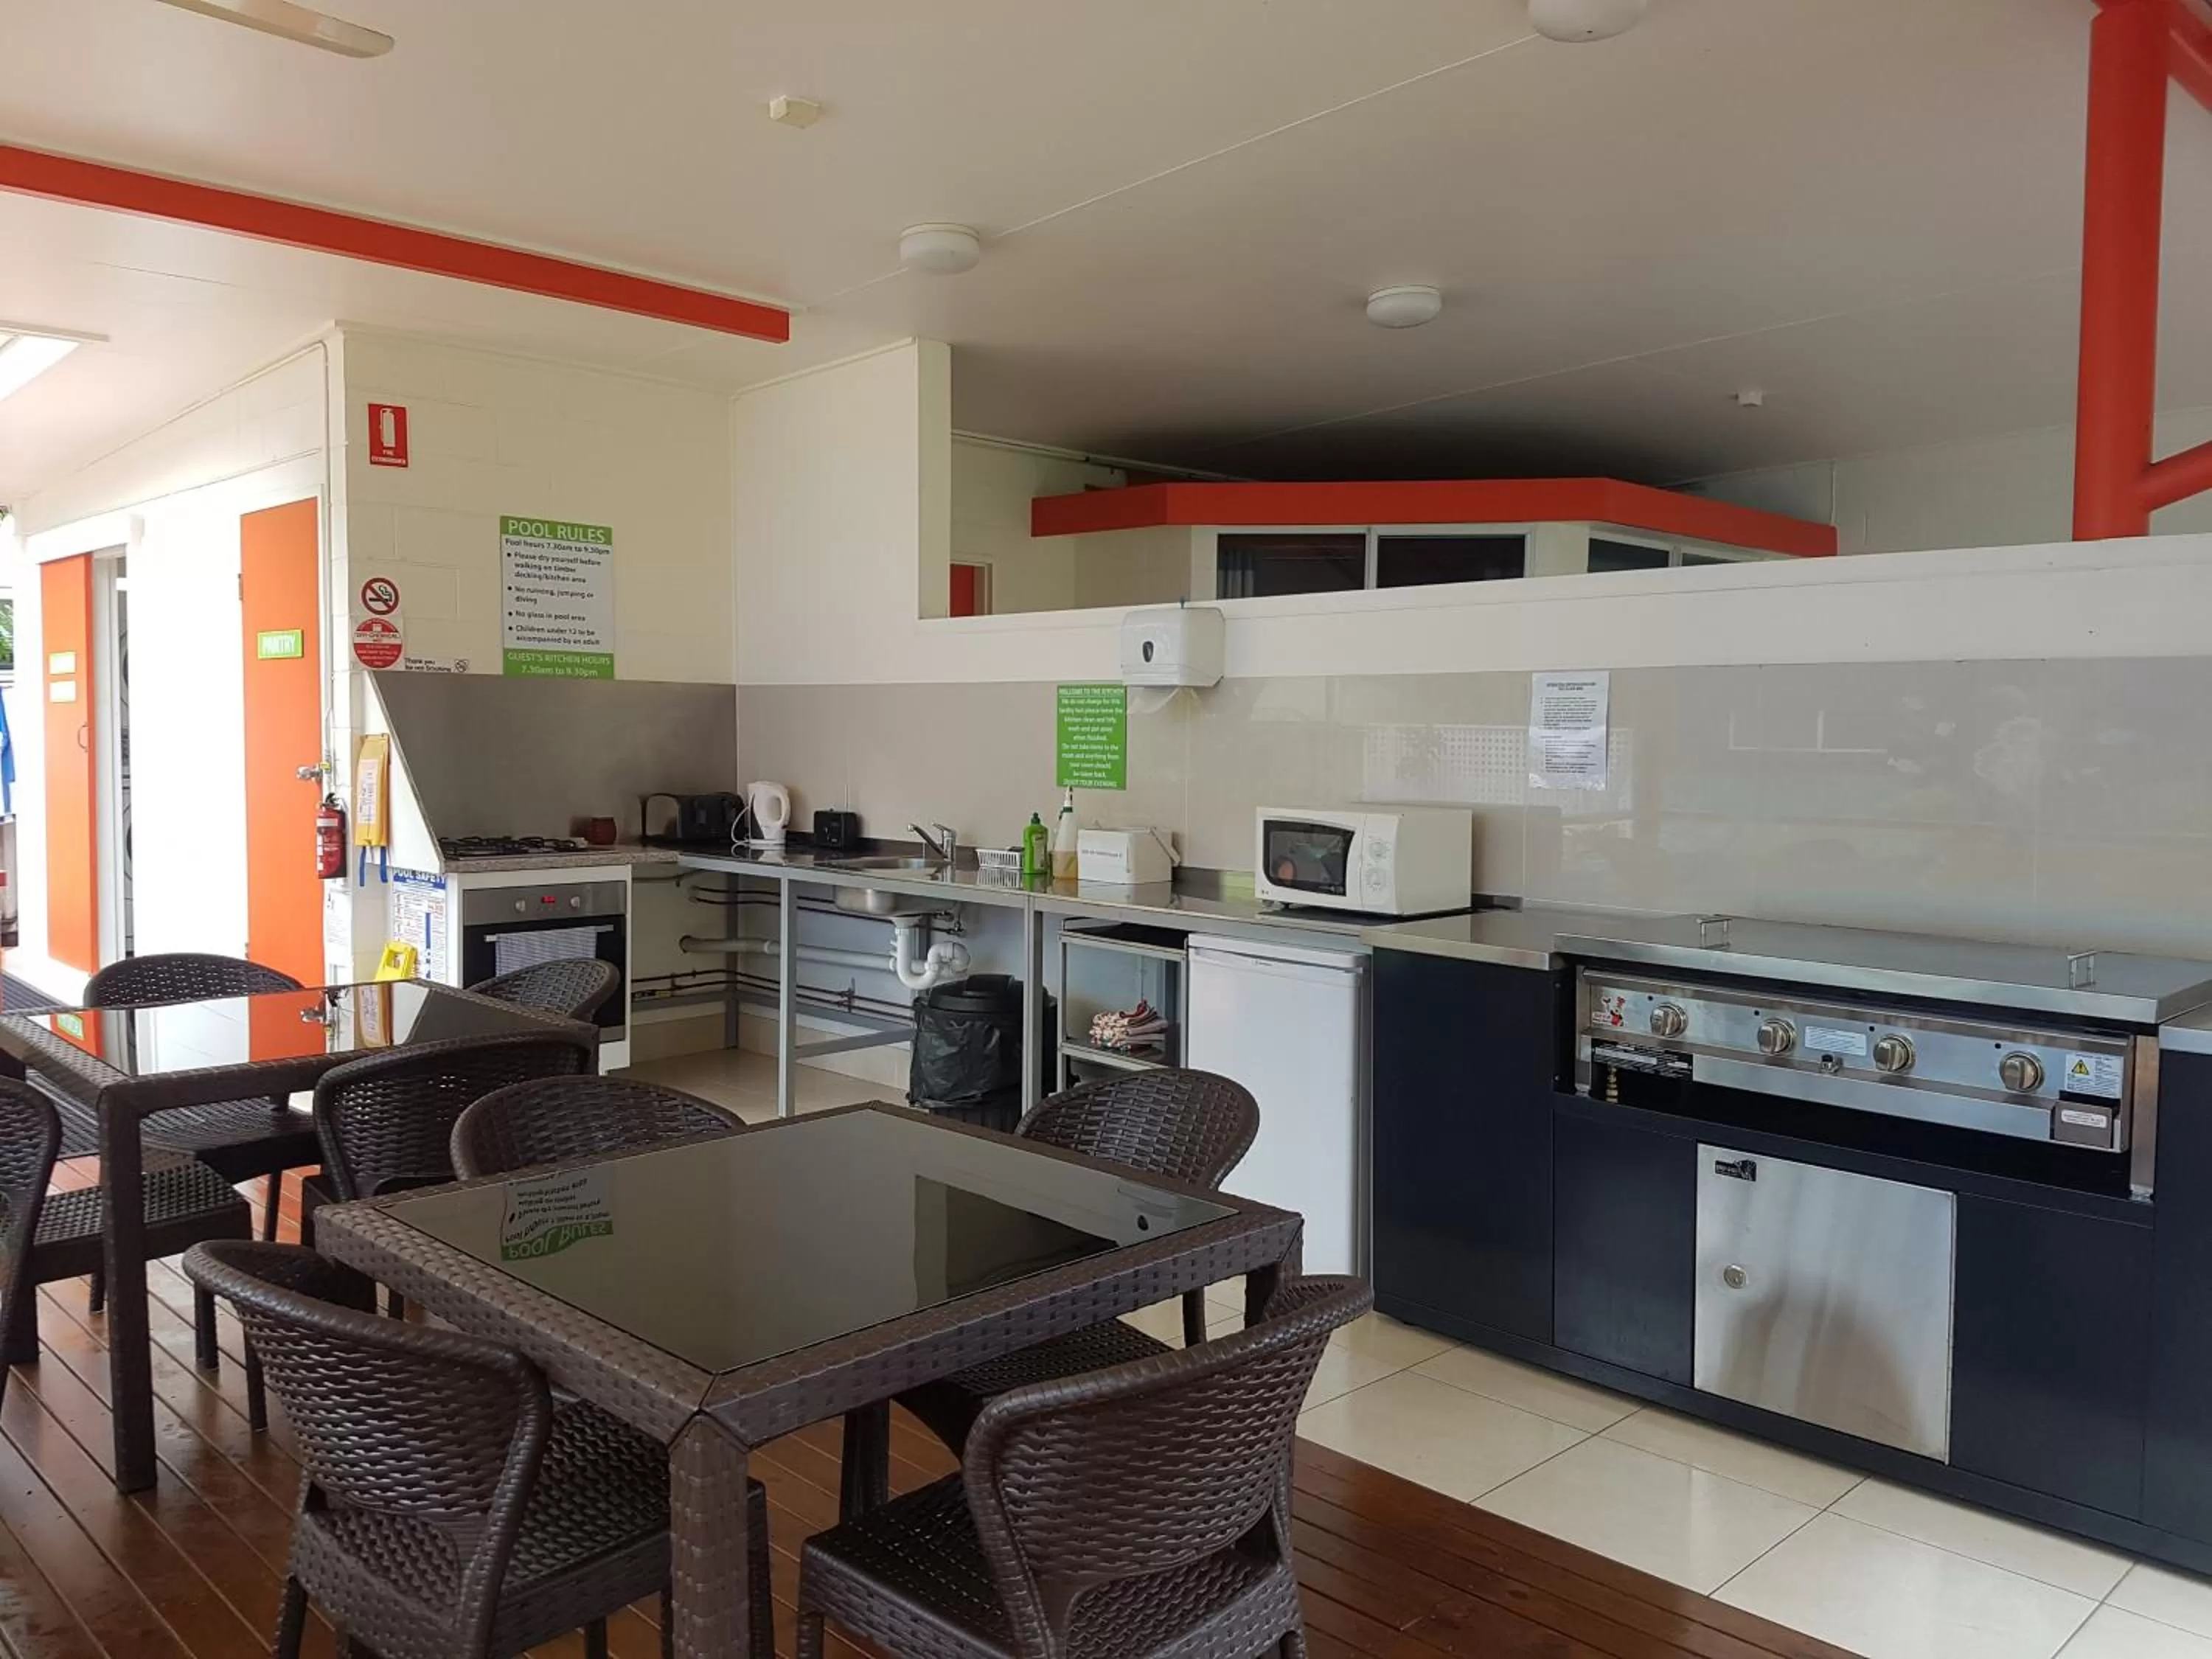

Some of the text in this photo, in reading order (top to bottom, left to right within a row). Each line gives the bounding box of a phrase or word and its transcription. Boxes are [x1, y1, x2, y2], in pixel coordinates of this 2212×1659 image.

[507, 520, 605, 543] POOL RULES
[505, 538, 522, 546] Pool
[523, 539, 545, 549] hours
[514, 552, 602, 566] Please dry yourself before
[514, 563, 542, 571] walking
[545, 654, 580, 664] KITCHEN
[582, 656, 611, 666] HOURS
